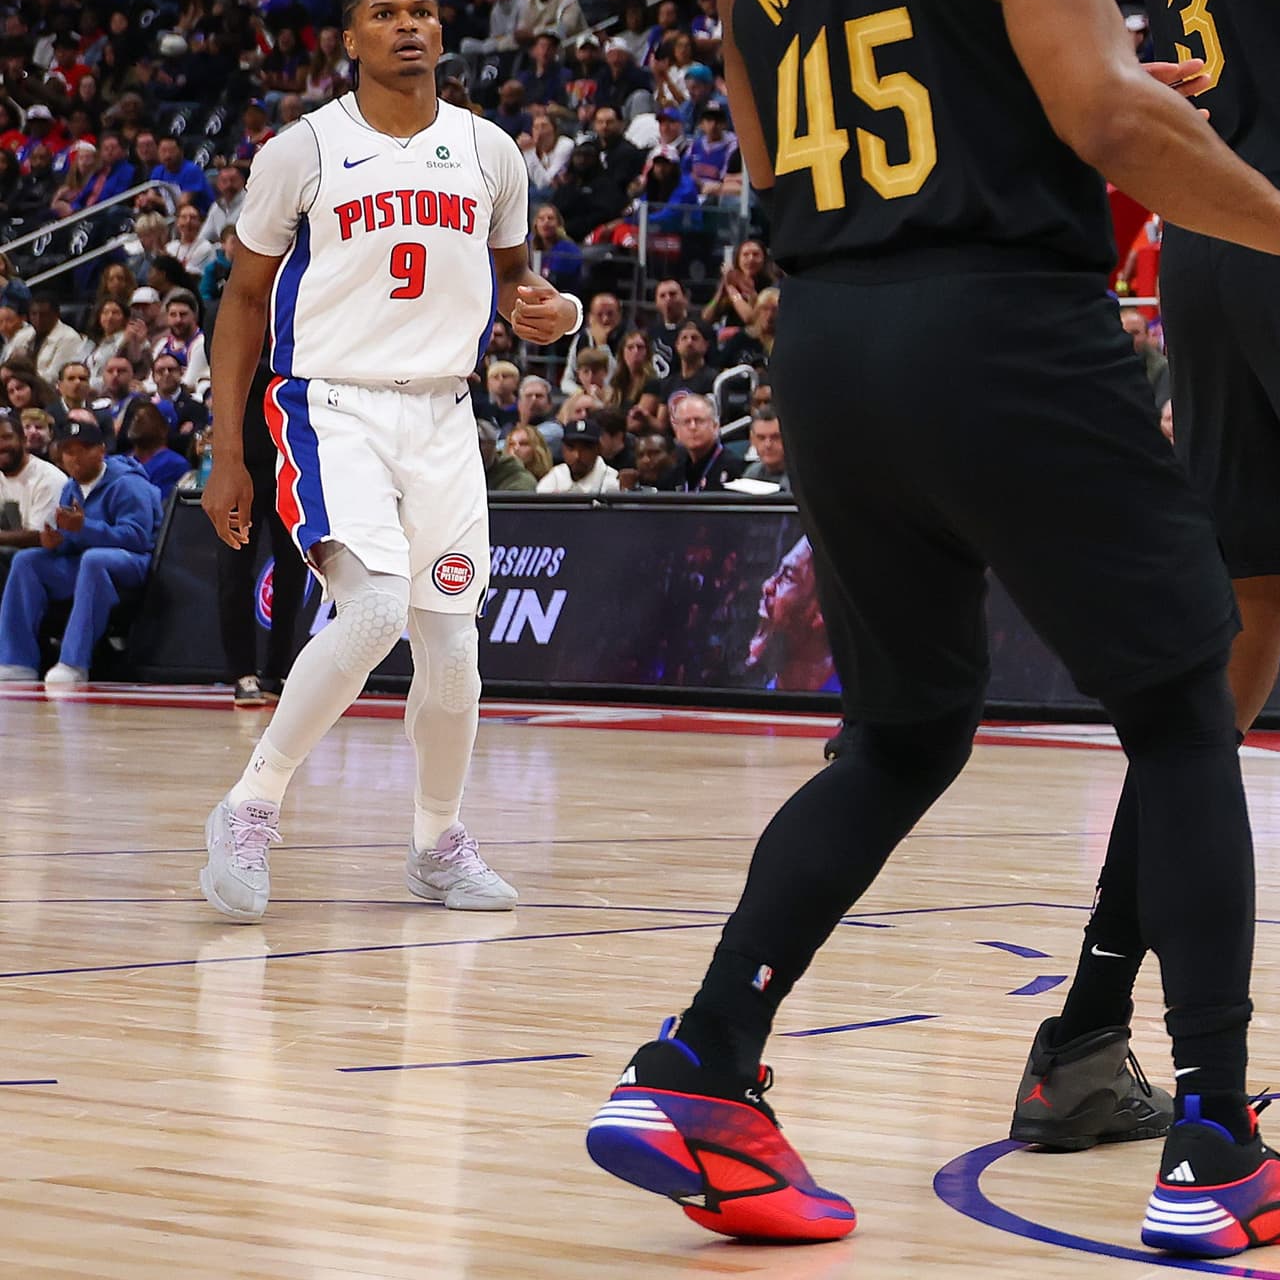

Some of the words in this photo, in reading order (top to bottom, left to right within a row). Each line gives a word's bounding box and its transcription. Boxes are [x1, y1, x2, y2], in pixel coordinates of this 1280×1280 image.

[775, 6, 938, 211] 45
[334, 189, 478, 241] PISTONS
[388, 242, 427, 300] 9
[490, 545, 566, 577] RSHIPS
[489, 588, 568, 645] IN
